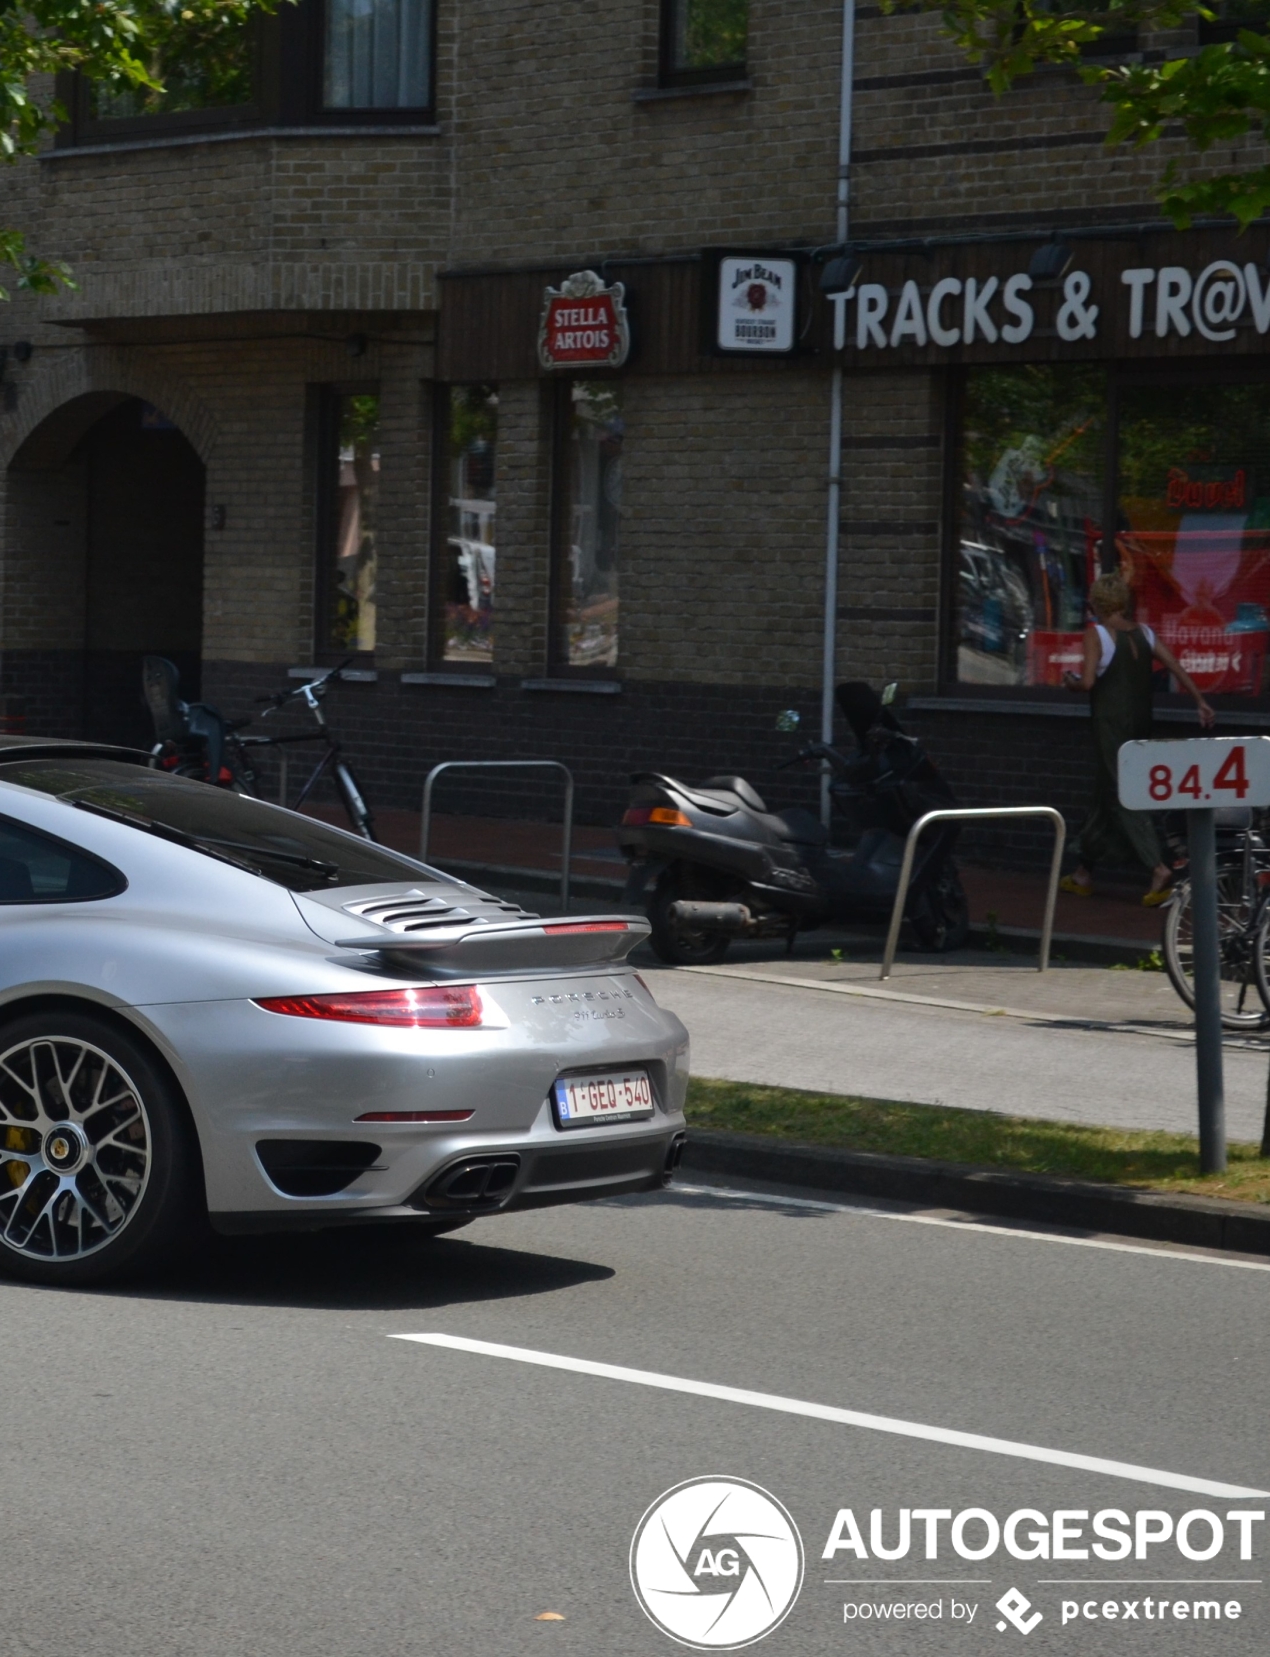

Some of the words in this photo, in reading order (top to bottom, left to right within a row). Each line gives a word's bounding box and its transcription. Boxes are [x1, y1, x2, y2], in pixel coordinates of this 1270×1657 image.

[554, 307, 608, 328] STELLA
[826, 272, 1035, 351] TRACKS
[1056, 270, 1100, 342] &
[554, 329, 610, 350] ARTOIS
[1148, 745, 1250, 802] 84.4
[530, 989, 634, 1006] PORSCHE
[560, 1101, 568, 1116] B
